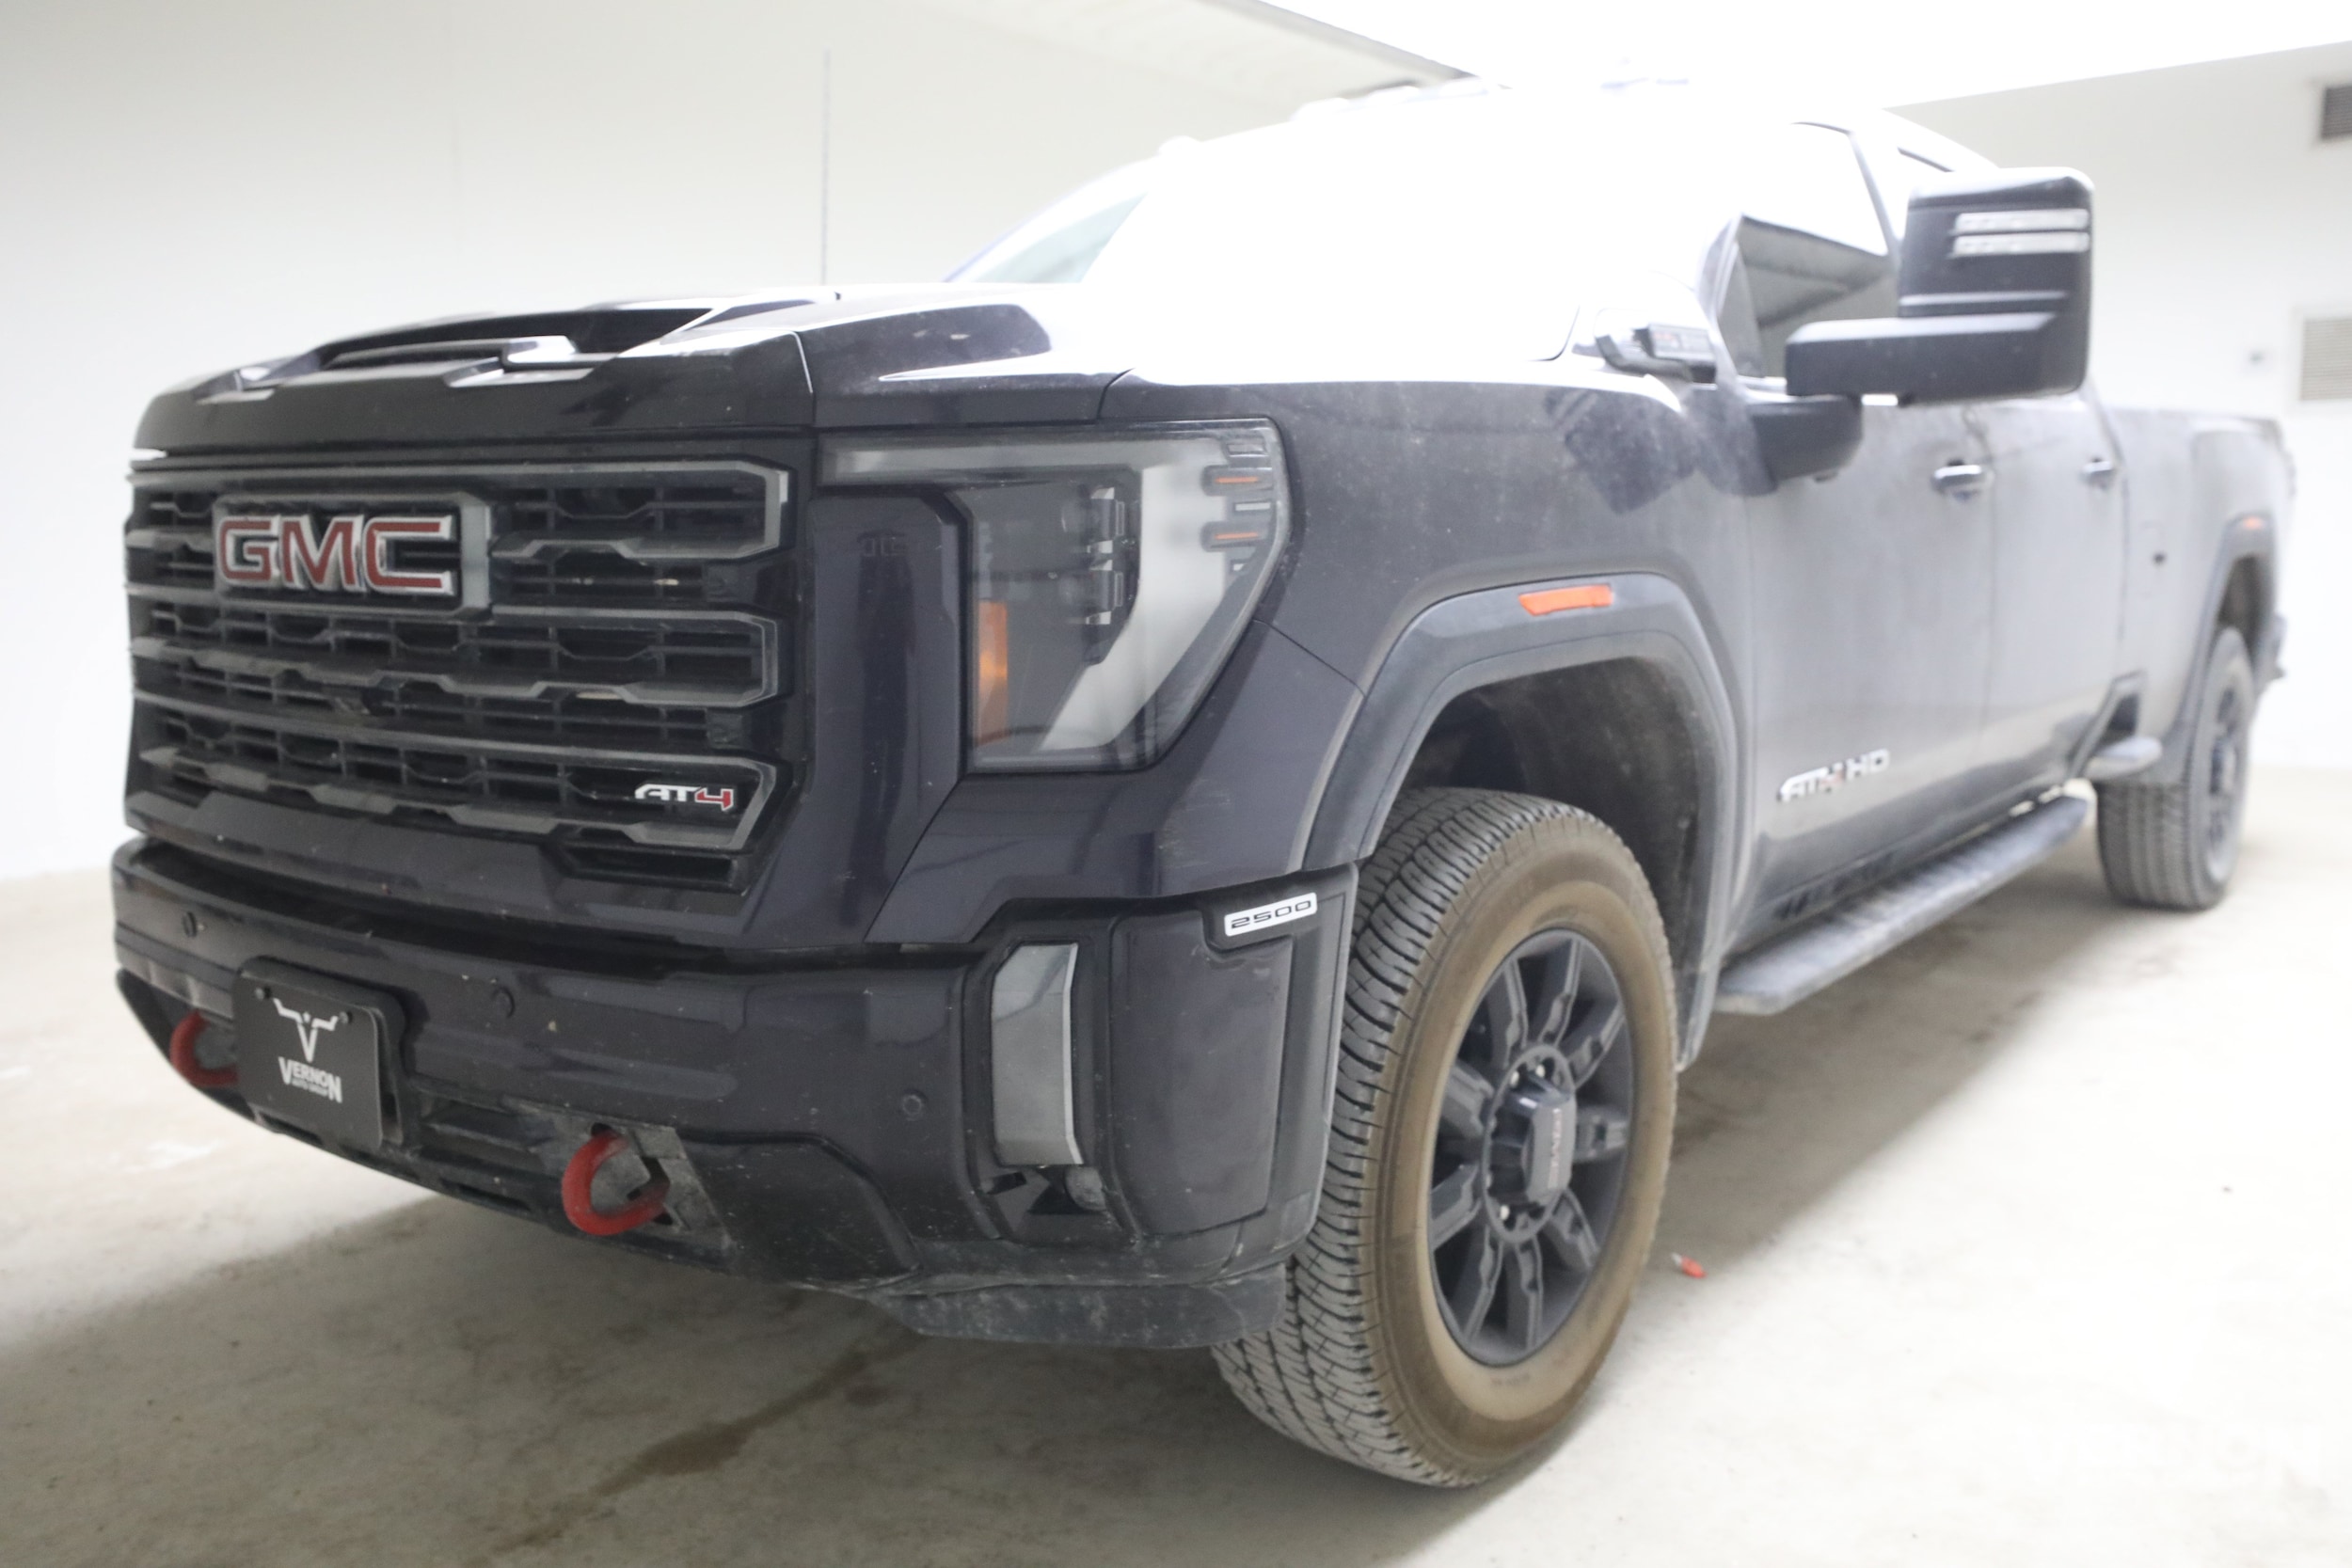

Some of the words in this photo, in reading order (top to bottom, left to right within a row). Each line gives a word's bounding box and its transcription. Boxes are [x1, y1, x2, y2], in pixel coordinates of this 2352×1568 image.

[217, 514, 454, 595] GMC
[634, 783, 734, 811] AT4
[1230, 900, 1311, 929] 2500
[278, 1055, 342, 1103] VERNON
